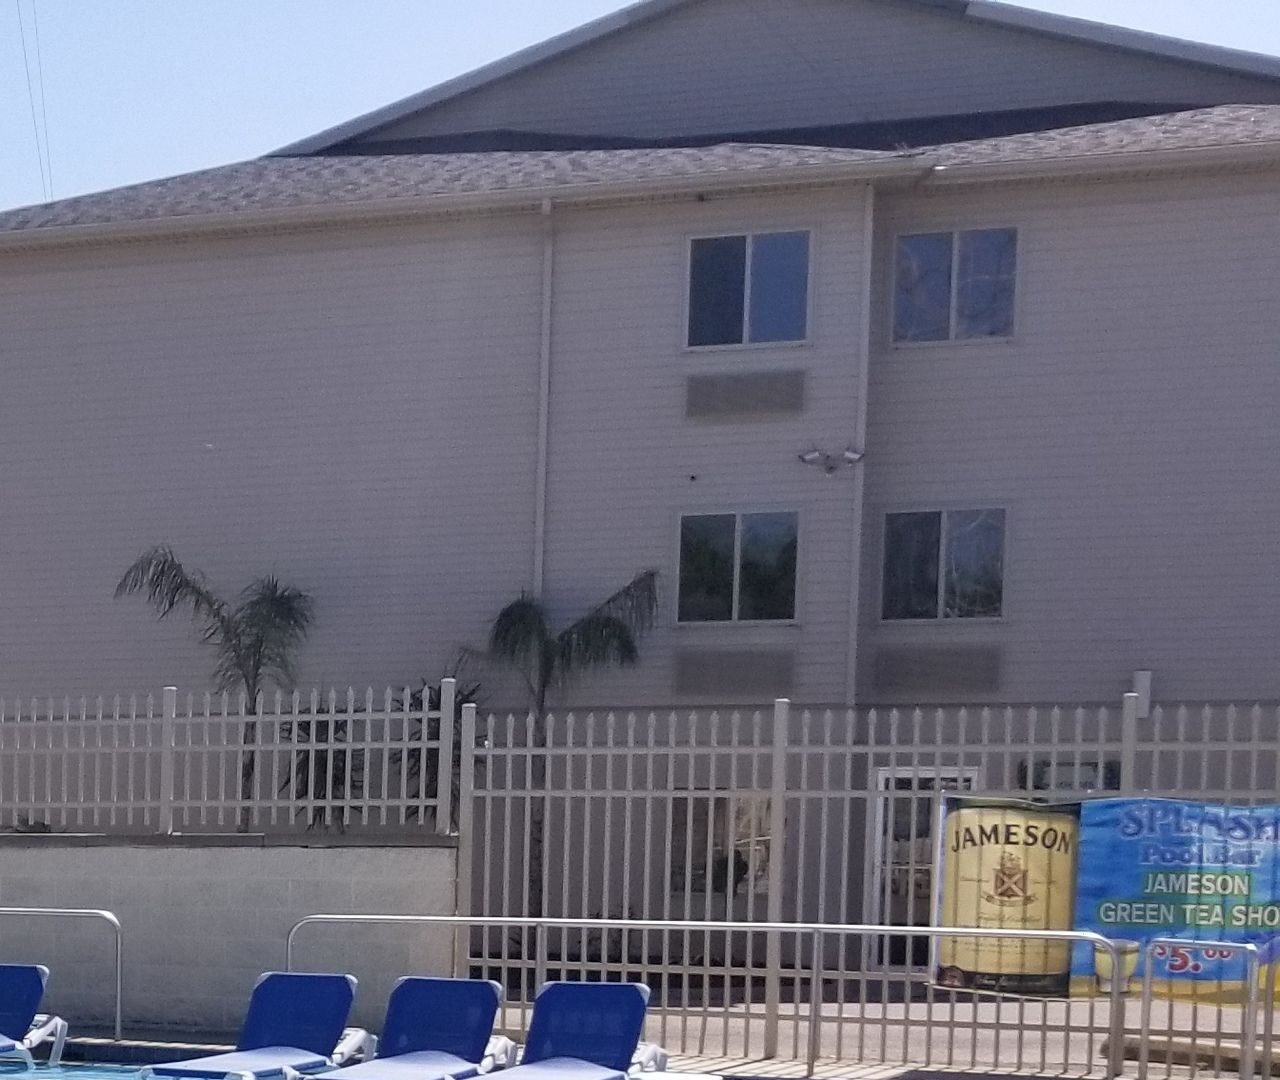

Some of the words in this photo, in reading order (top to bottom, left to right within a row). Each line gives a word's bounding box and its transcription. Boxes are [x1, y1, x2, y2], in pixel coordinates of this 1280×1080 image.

[951, 823, 1071, 855] JAMESON
[1143, 873, 1250, 896] JAMESON
[1099, 902, 1175, 924] GREEN
[1181, 904, 1225, 926] TEA
